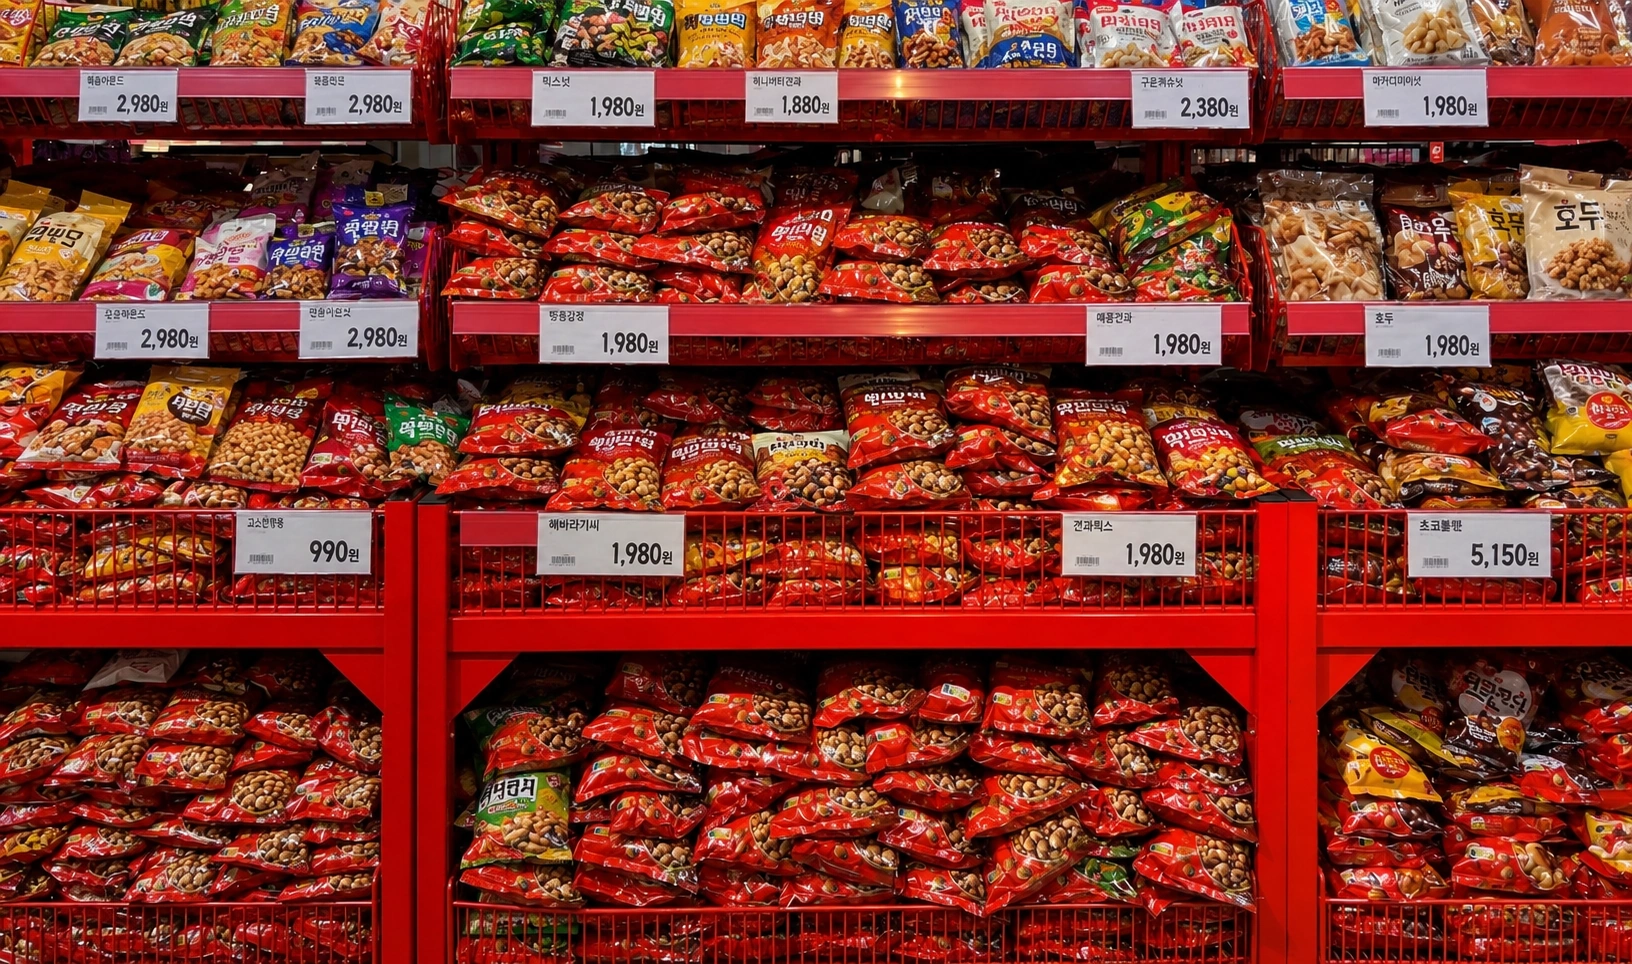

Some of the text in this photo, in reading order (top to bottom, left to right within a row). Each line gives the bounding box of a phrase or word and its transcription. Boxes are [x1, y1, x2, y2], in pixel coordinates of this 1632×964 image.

[542, 75, 571, 88] 믹스넛
[116, 93, 169, 115] 2,980원
[348, 94, 403, 116] 2,980원
[590, 96, 645, 119] 1,980원
[781, 95, 830, 116] 1,880원
[1180, 96, 1239, 120] 2,380원
[1423, 95, 1478, 118] 1,980원
[1553, 198, 1604, 231] 호두
[1375, 312, 1394, 325] 호두
[140, 328, 199, 351] 2,980원
[347, 326, 408, 350] 2,980원
[601, 331, 659, 356] 1,980원
[1153, 333, 1211, 357] 1,980원
[1425, 334, 1480, 359] 1,980원
[548, 518, 600, 532] 해바라기씨
[309, 539, 360, 563] 990원
[611, 541, 673, 567] 1,980원
[1126, 542, 1185, 568] 1,980원
[1470, 542, 1540, 569] 5,150원
